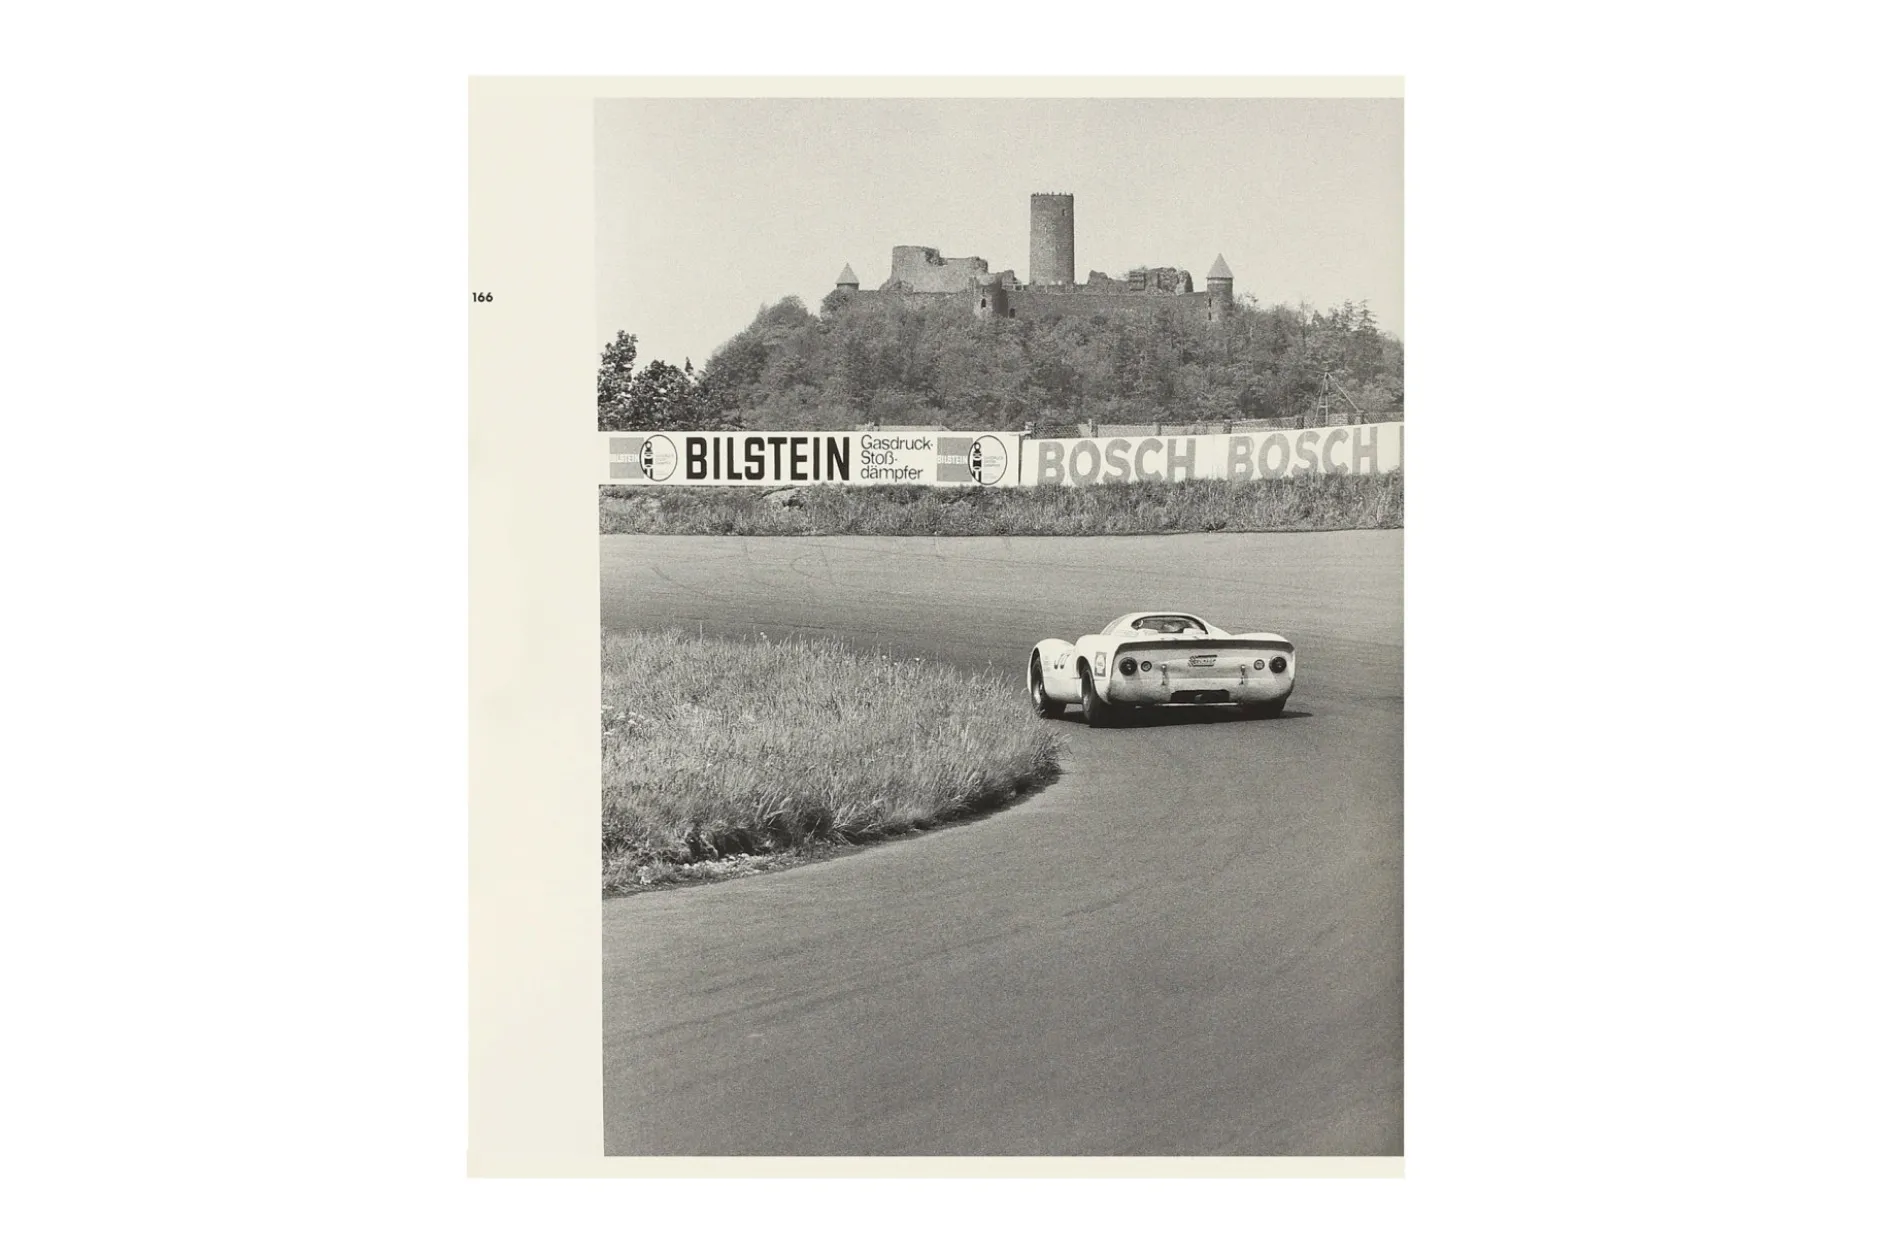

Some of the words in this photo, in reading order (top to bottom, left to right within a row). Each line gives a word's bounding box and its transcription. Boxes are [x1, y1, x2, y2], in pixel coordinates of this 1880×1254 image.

[472, 292, 494, 303] 166
[861, 434, 933, 450] Gasdruck-
[686, 437, 850, 480] BILSTEIN
[937, 454, 968, 464] BILSTEIN
[1037, 438, 1196, 486] BOSCH
[1227, 427, 1378, 481] BOSCH
[860, 465, 924, 482] dämpfer
